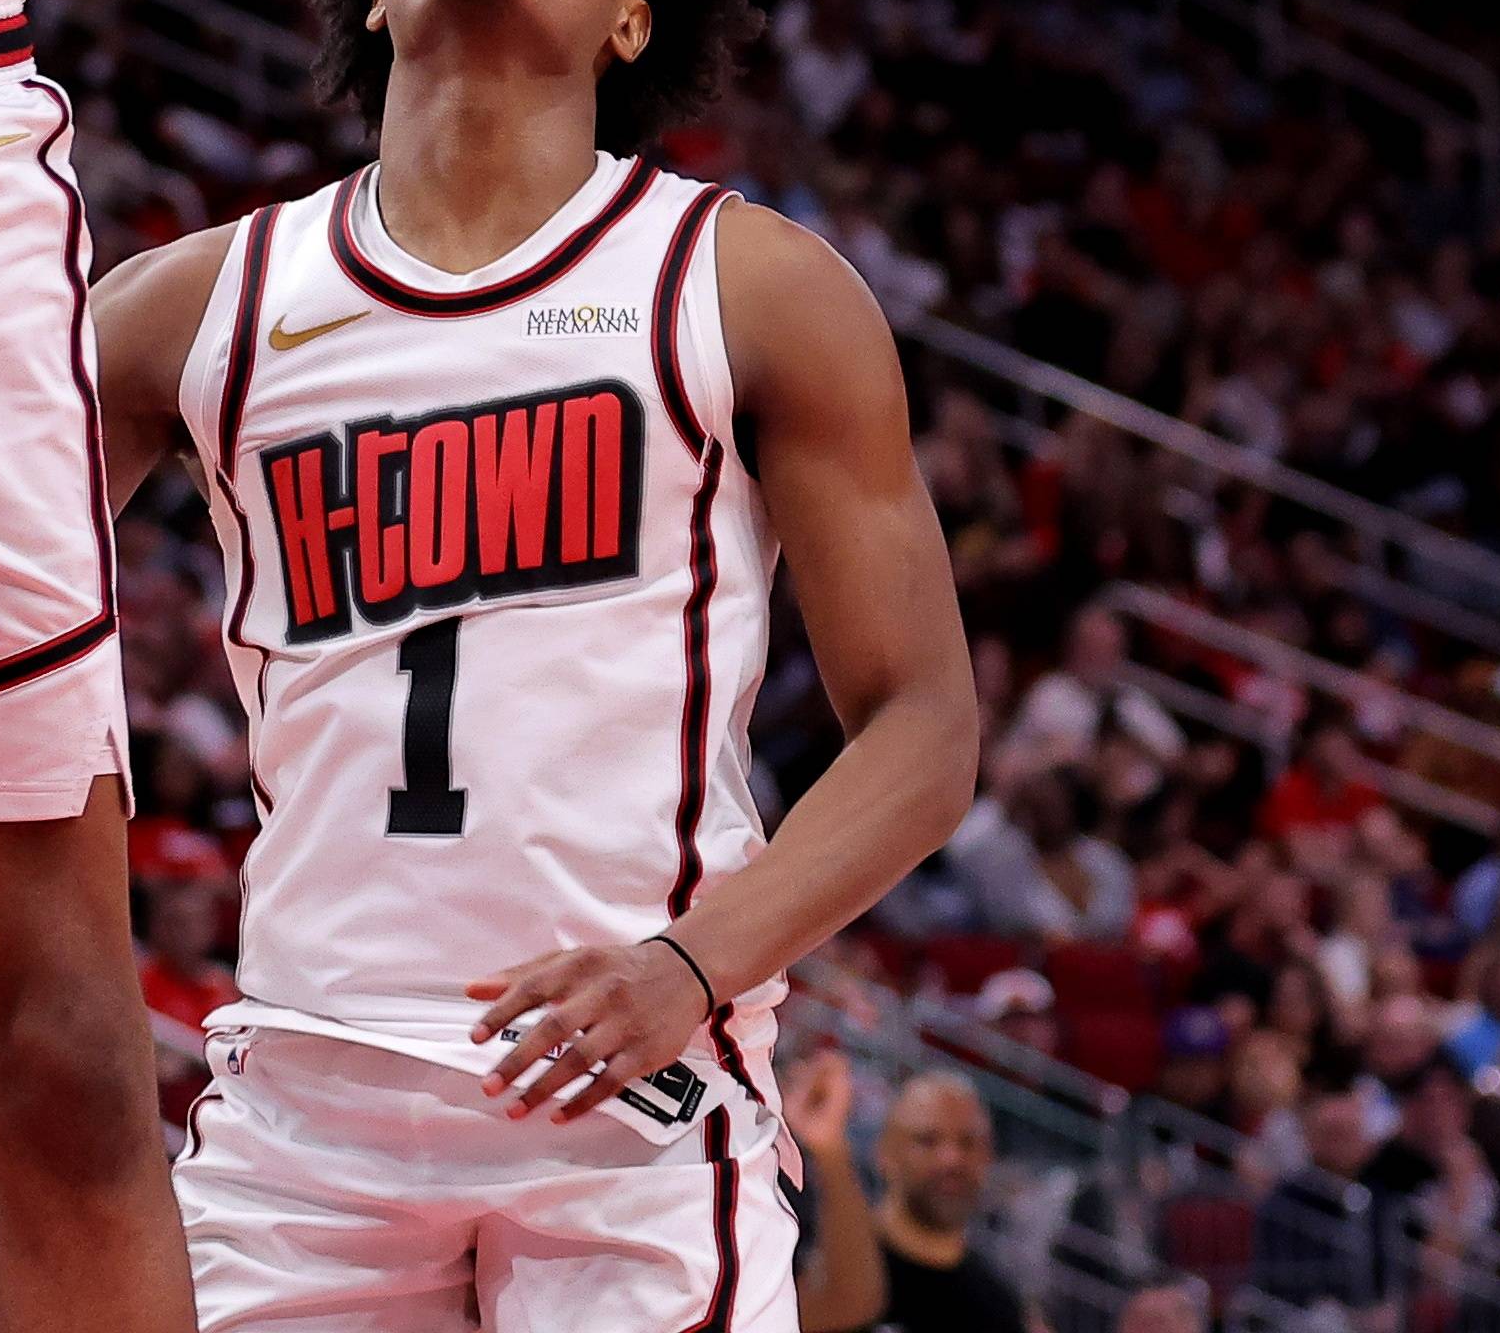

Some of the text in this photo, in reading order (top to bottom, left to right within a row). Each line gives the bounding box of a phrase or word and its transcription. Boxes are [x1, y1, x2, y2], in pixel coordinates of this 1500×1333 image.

[528, 306, 640, 323] MEMORIAL
[527, 319, 639, 335] HERMANN
[384, 617, 468, 837] 1
